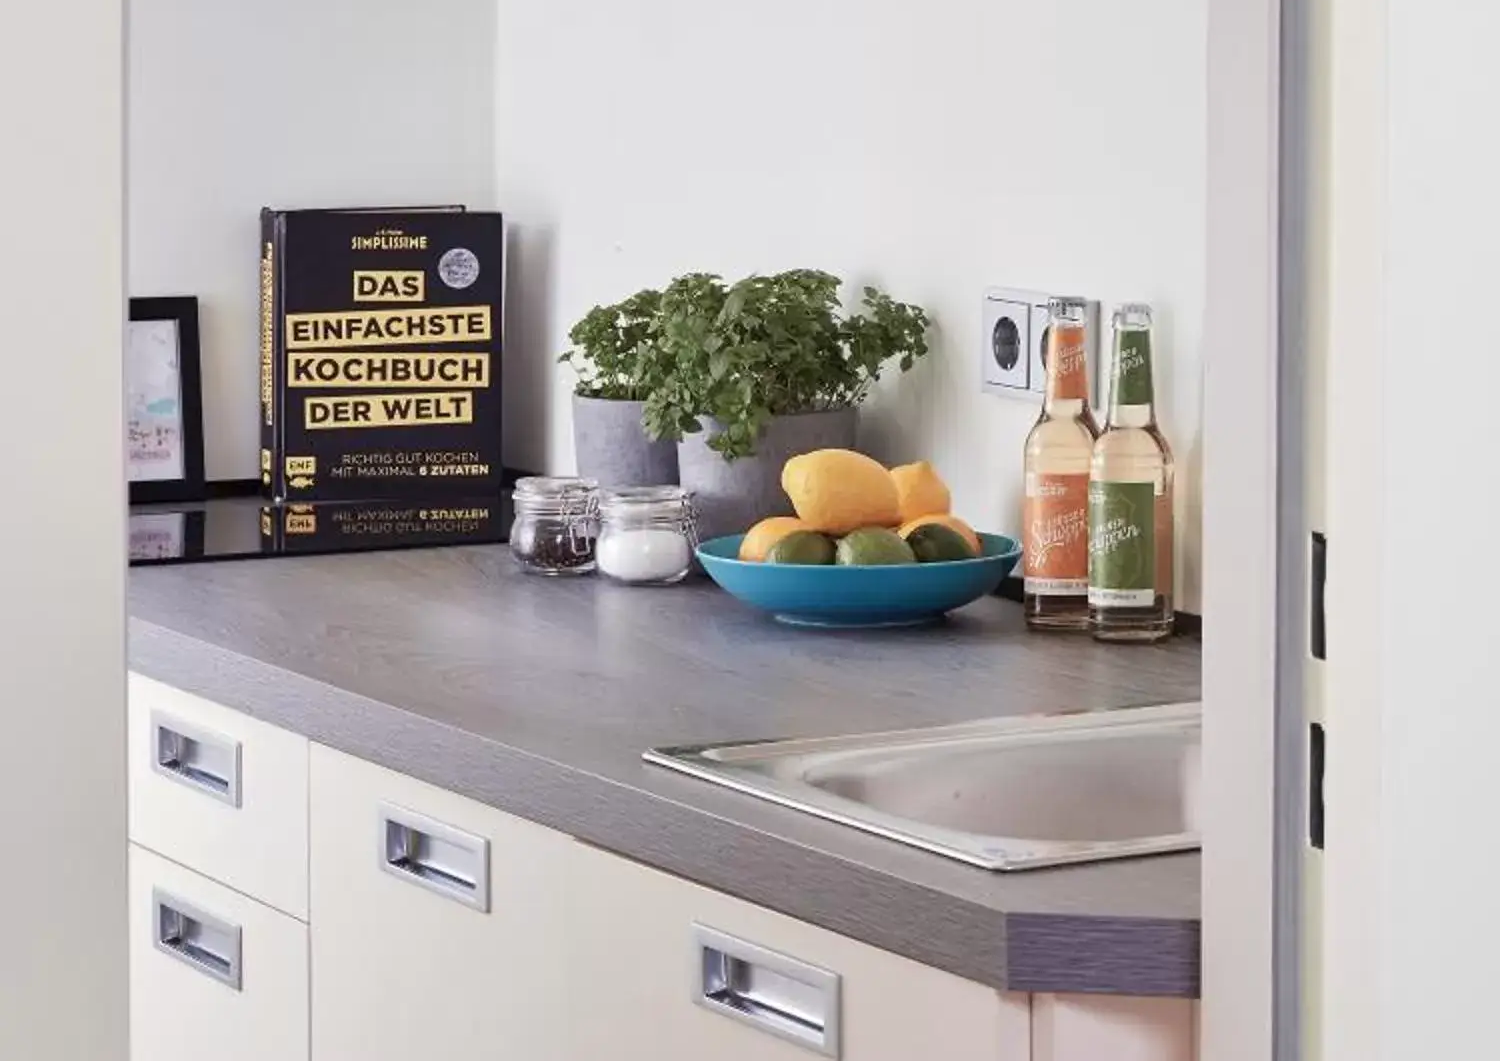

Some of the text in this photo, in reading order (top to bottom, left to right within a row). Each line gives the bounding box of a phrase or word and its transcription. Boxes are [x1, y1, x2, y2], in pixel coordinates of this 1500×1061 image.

[351, 236, 428, 250] SIMPLISSIME
[358, 275, 419, 296] DAS
[293, 313, 484, 342] EINFACHSTE
[294, 358, 483, 381] KOCHBUCH
[310, 397, 467, 423] DER WELT
[342, 451, 480, 465] RICHTIG GUT KOCHEN
[330, 464, 489, 478] MIT MAXIMAL 6 ZUTATEN
